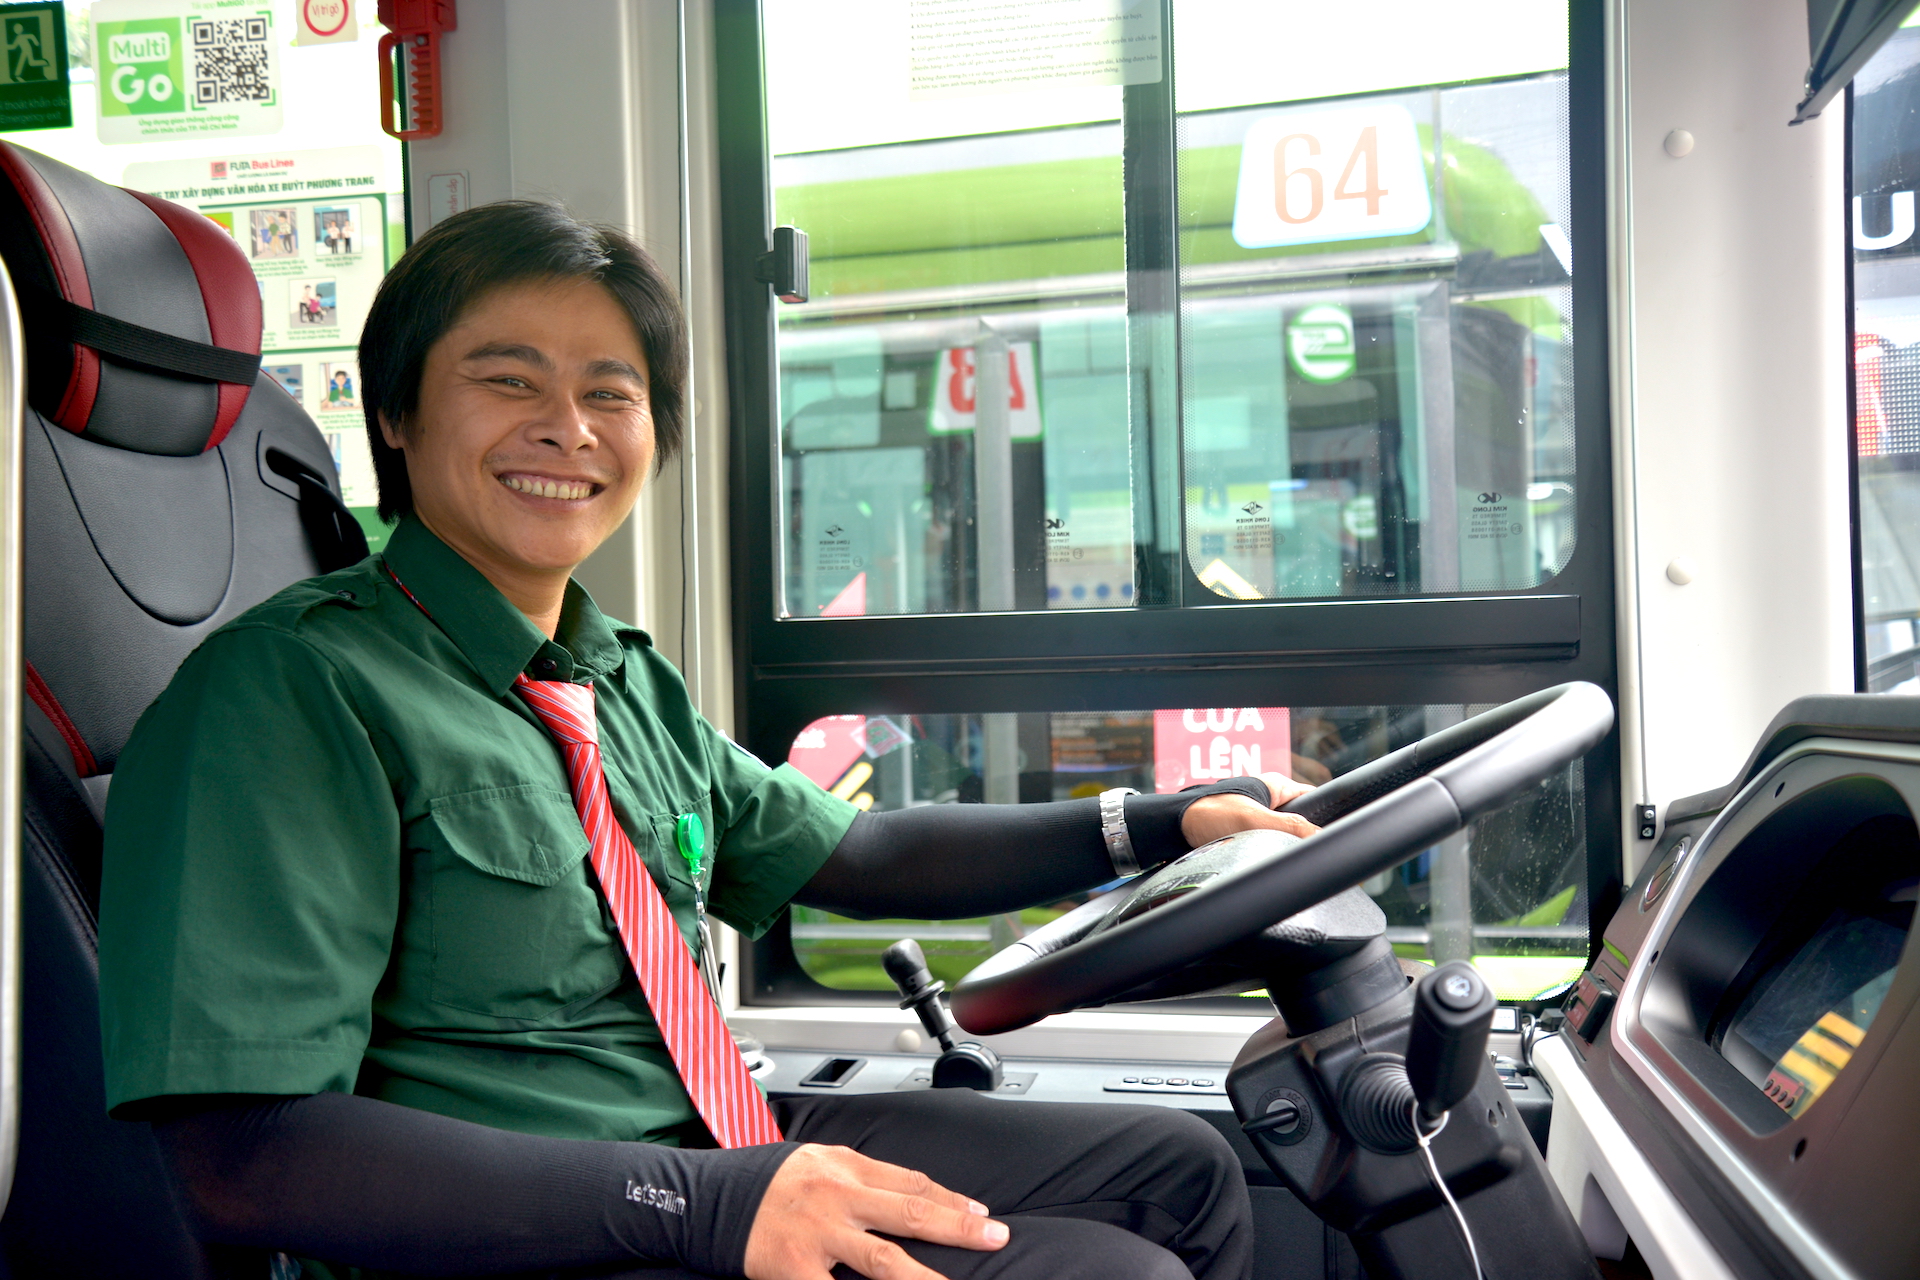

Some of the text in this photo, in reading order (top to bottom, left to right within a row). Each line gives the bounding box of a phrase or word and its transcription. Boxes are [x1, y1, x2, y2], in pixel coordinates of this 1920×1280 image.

[114, 38, 166, 58] Multi
[111, 66, 173, 104] Go
[230, 159, 294, 171] FUTA Bus Lines
[1273, 126, 1389, 225] 64
[164, 190, 180, 199] TAY
[182, 187, 199, 198] XÂY
[201, 187, 225, 199] DỰNG
[227, 184, 245, 195] VĂN
[346, 176, 375, 187] TRANG
[1190, 736, 1261, 778] LÊN
